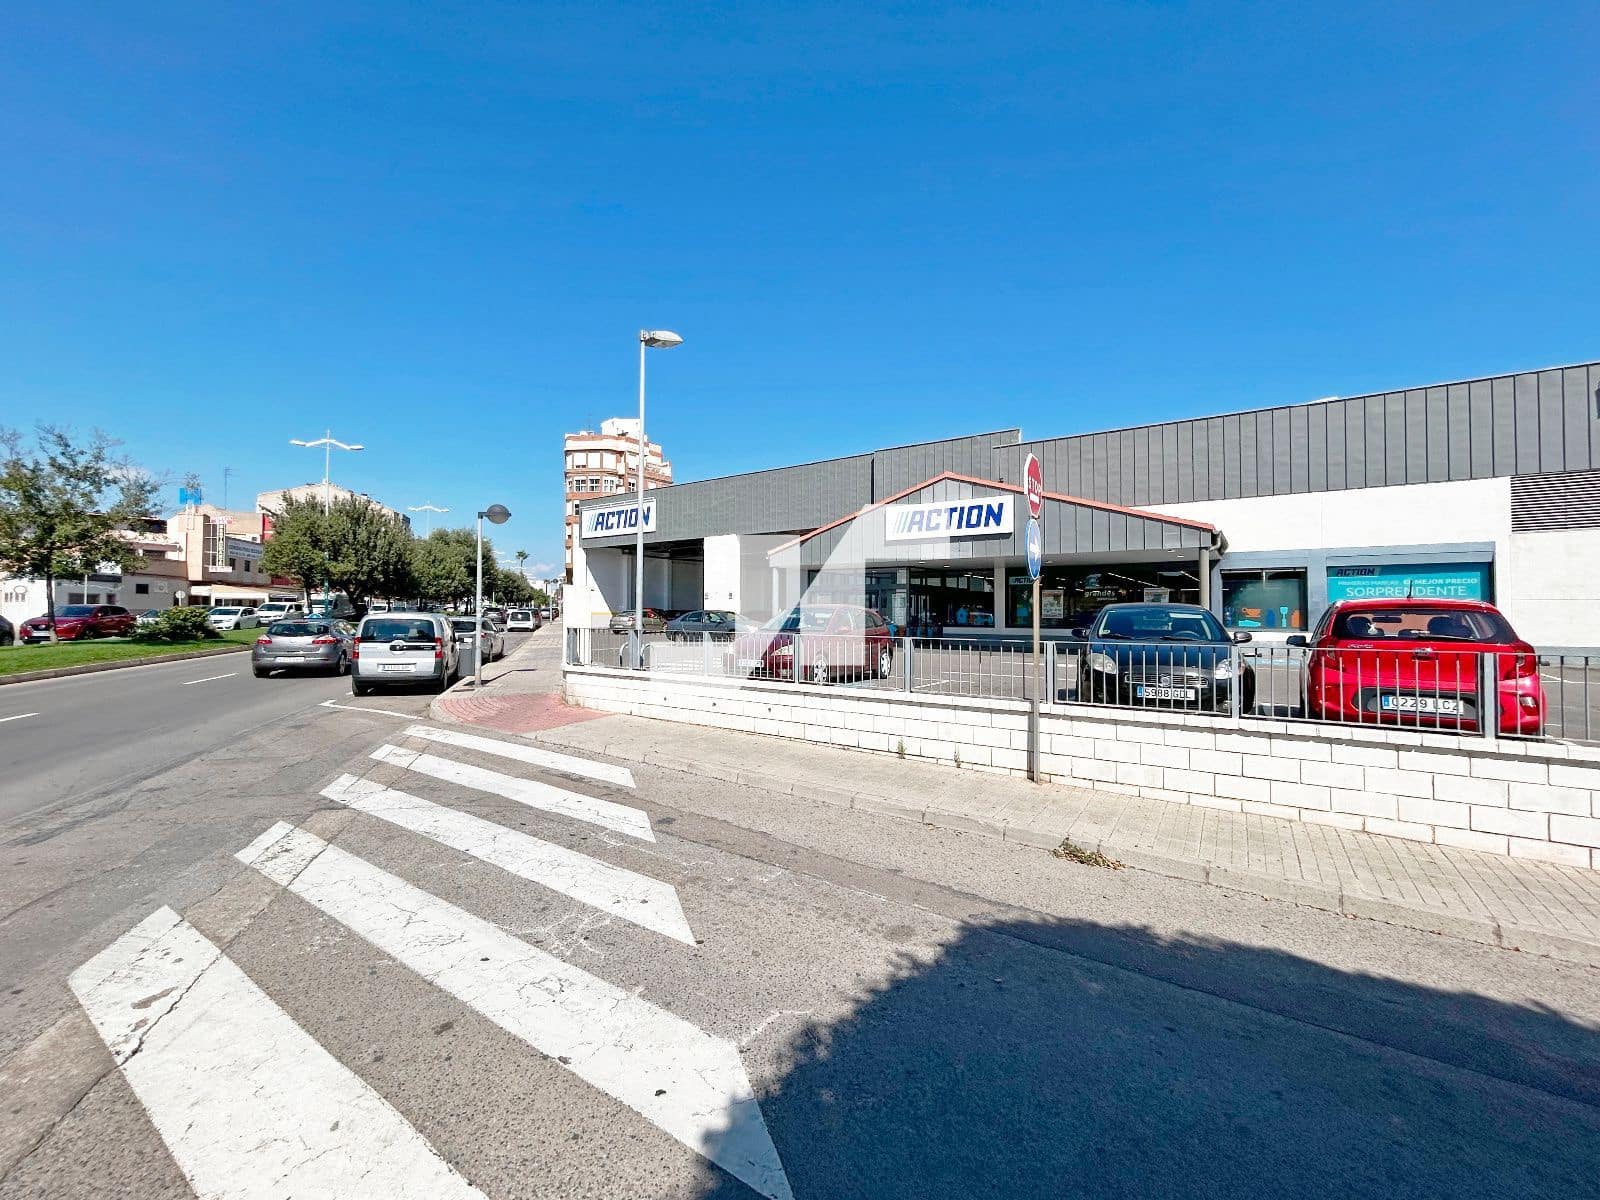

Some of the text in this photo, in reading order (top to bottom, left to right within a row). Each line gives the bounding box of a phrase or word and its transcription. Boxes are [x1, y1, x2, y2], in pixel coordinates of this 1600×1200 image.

[1029, 476, 1041, 495] STOP
[594, 506, 651, 531] ACTION
[906, 502, 1004, 533] ACTION
[1336, 568, 1376, 577] ACTION
[1346, 585, 1468, 597] SORPRENDENTE
